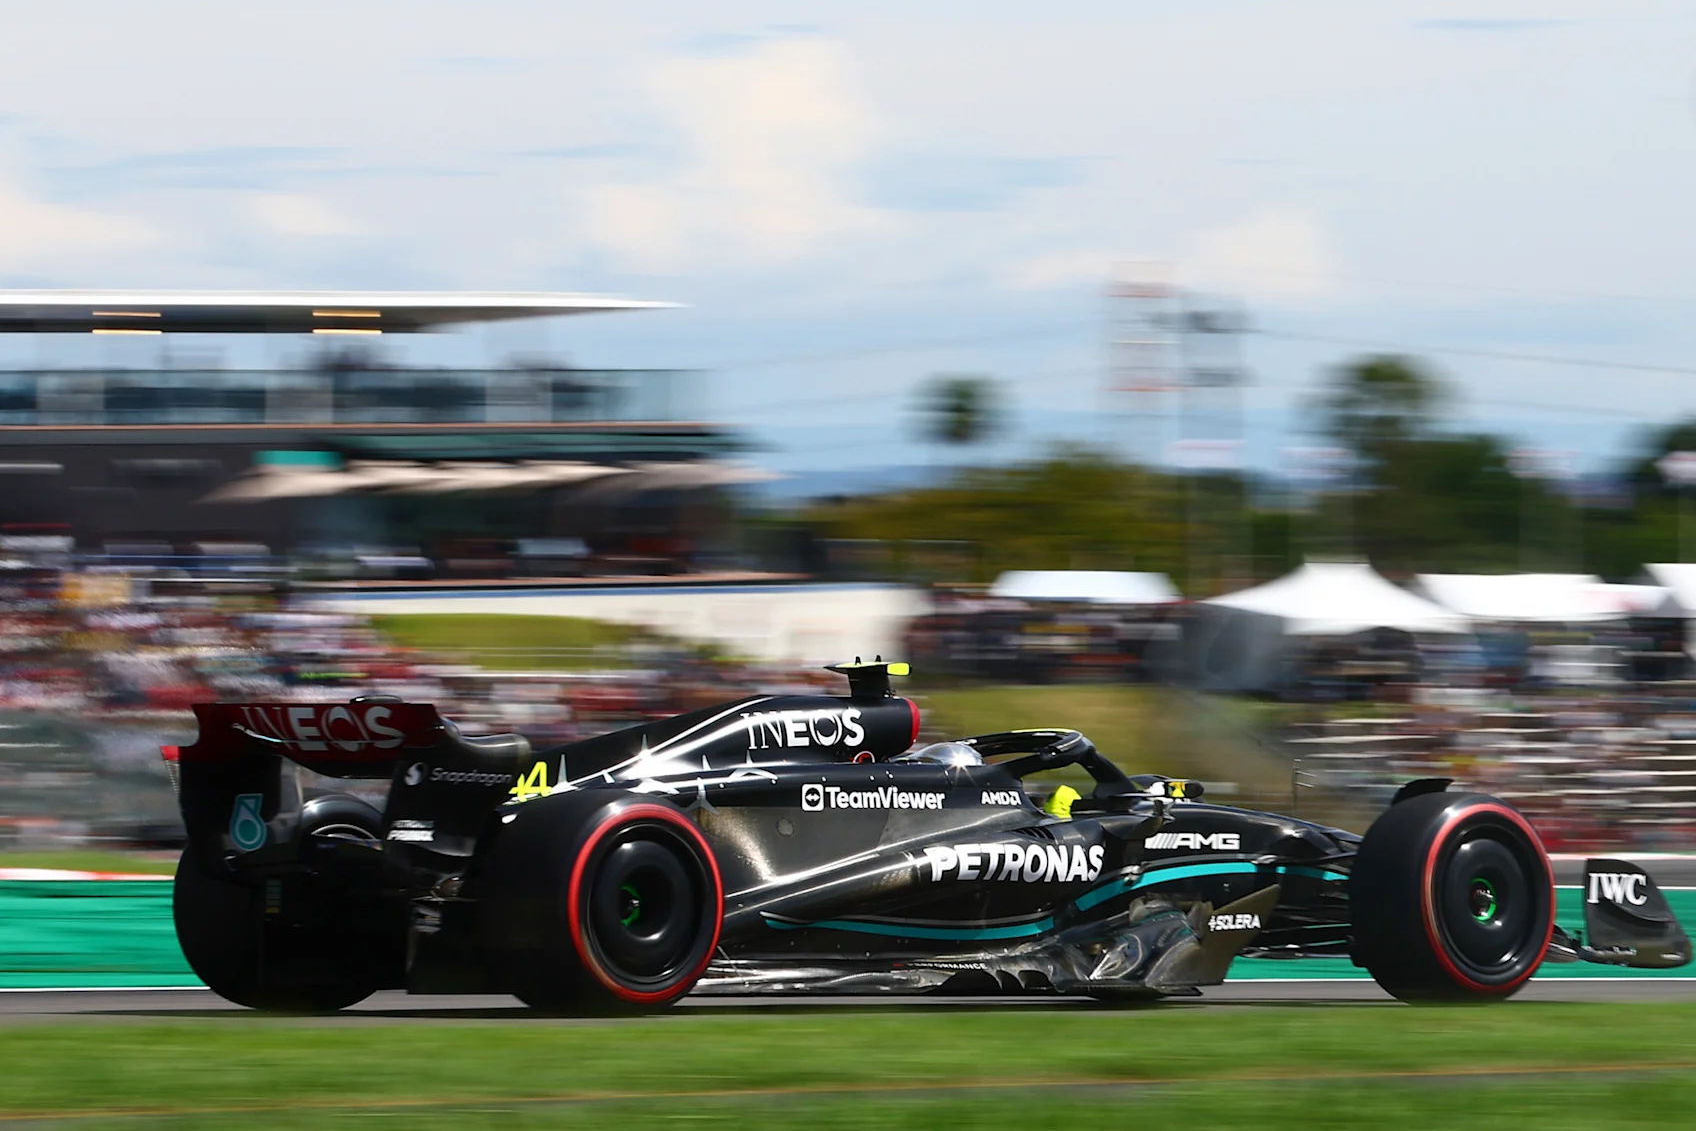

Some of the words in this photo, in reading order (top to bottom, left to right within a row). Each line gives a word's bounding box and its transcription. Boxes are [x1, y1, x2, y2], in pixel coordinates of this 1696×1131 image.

[240, 705, 406, 752] INEOS
[740, 707, 865, 750] INEOS
[430, 767, 513, 787] Snapdragon
[825, 786, 945, 810] TeamViewer
[981, 791, 1010, 806] AMD
[1174, 833, 1240, 850] AMG
[923, 843, 1105, 883] PETRONAS
[1587, 873, 1648, 906] IWC
[1215, 914, 1261, 930] SOLERA
